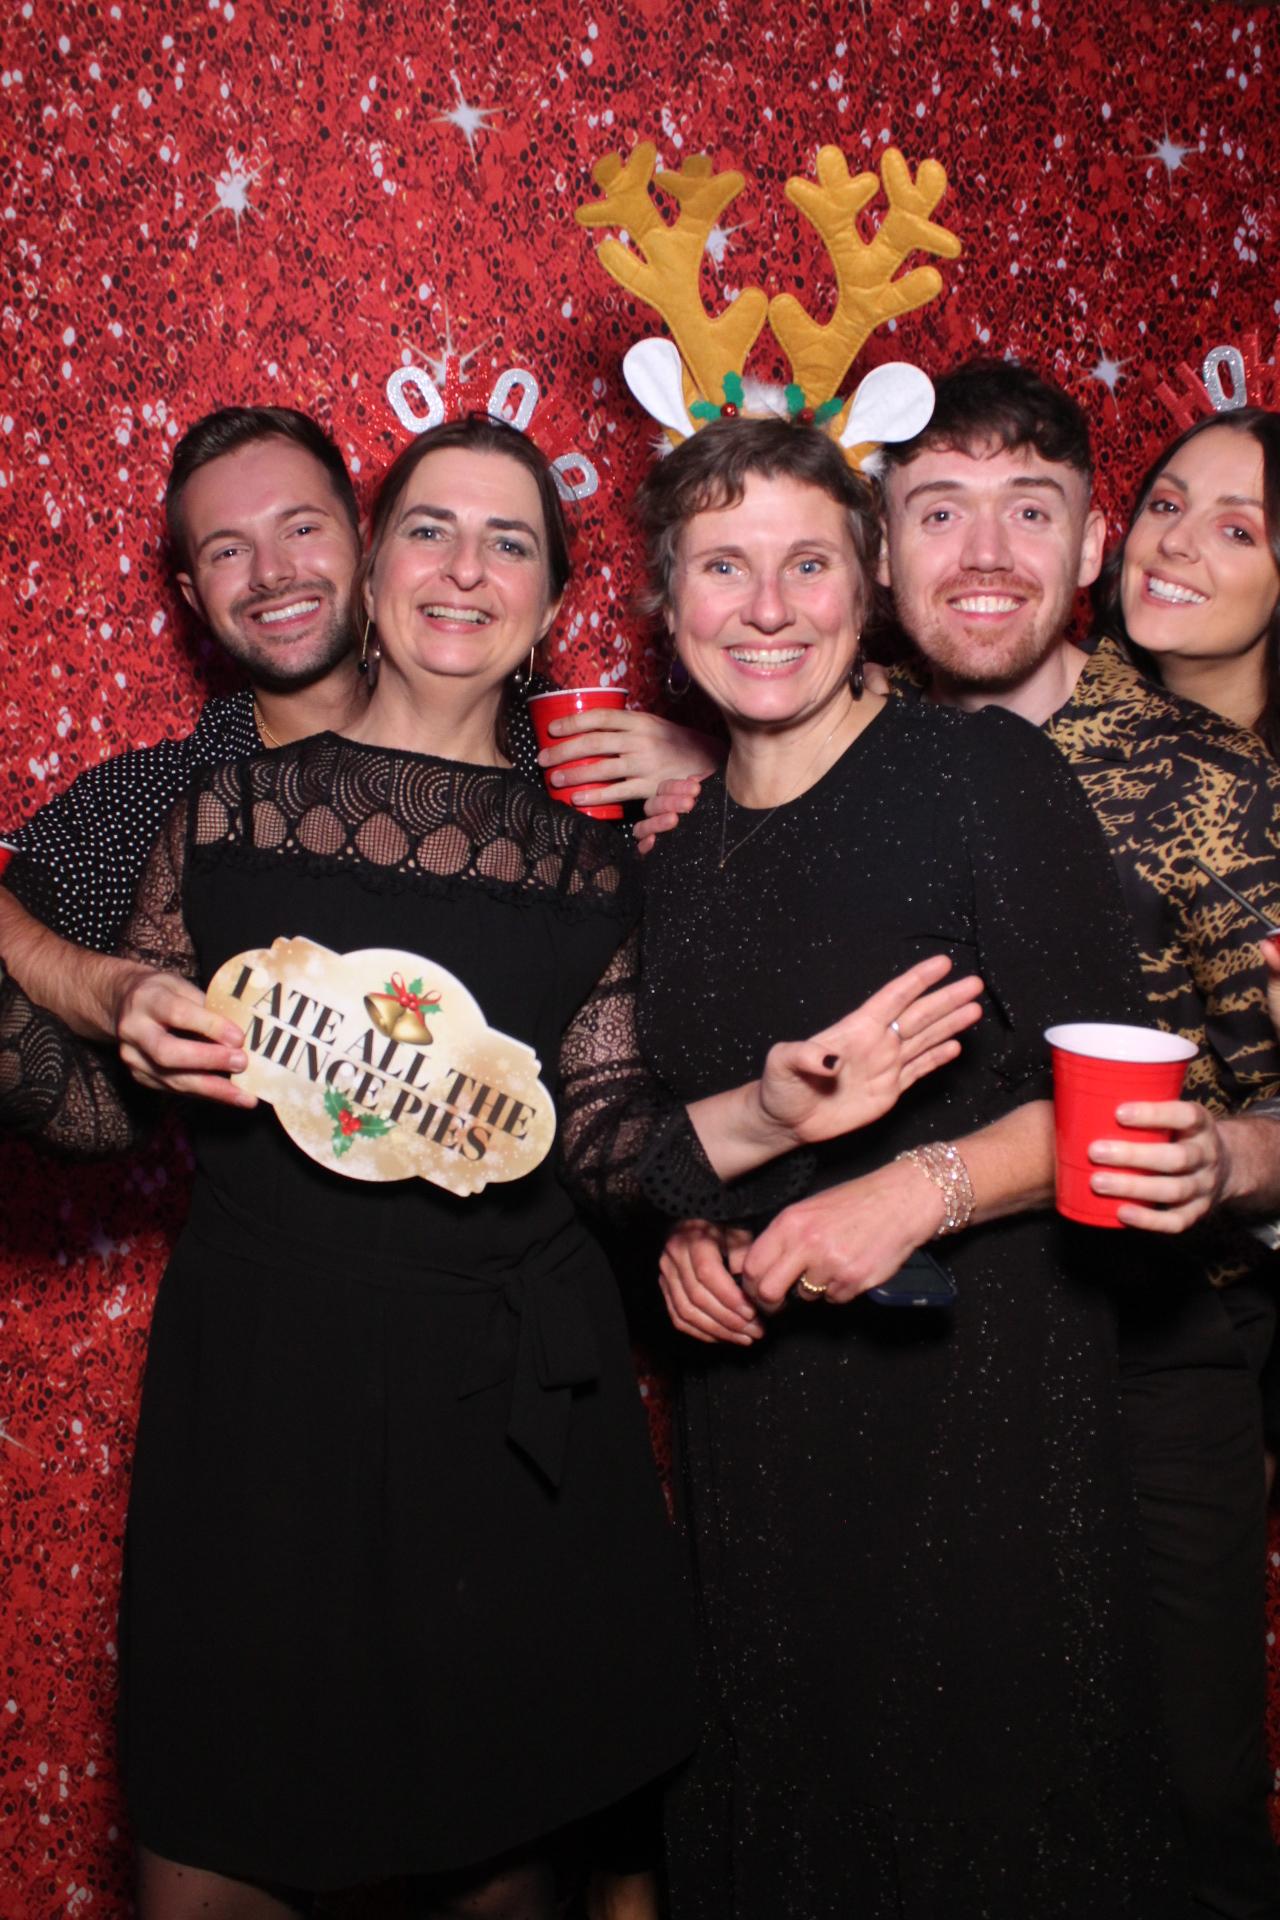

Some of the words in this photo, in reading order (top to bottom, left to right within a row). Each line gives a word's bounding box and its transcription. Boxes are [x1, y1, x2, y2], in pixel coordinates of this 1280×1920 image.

[230, 965, 253, 1000] I
[253, 982, 345, 1046] ATE
[346, 1028, 431, 1092] ALL
[445, 1068, 536, 1140] THE
[246, 1014, 386, 1111] MINCE
[387, 1090, 492, 1161] PIES
